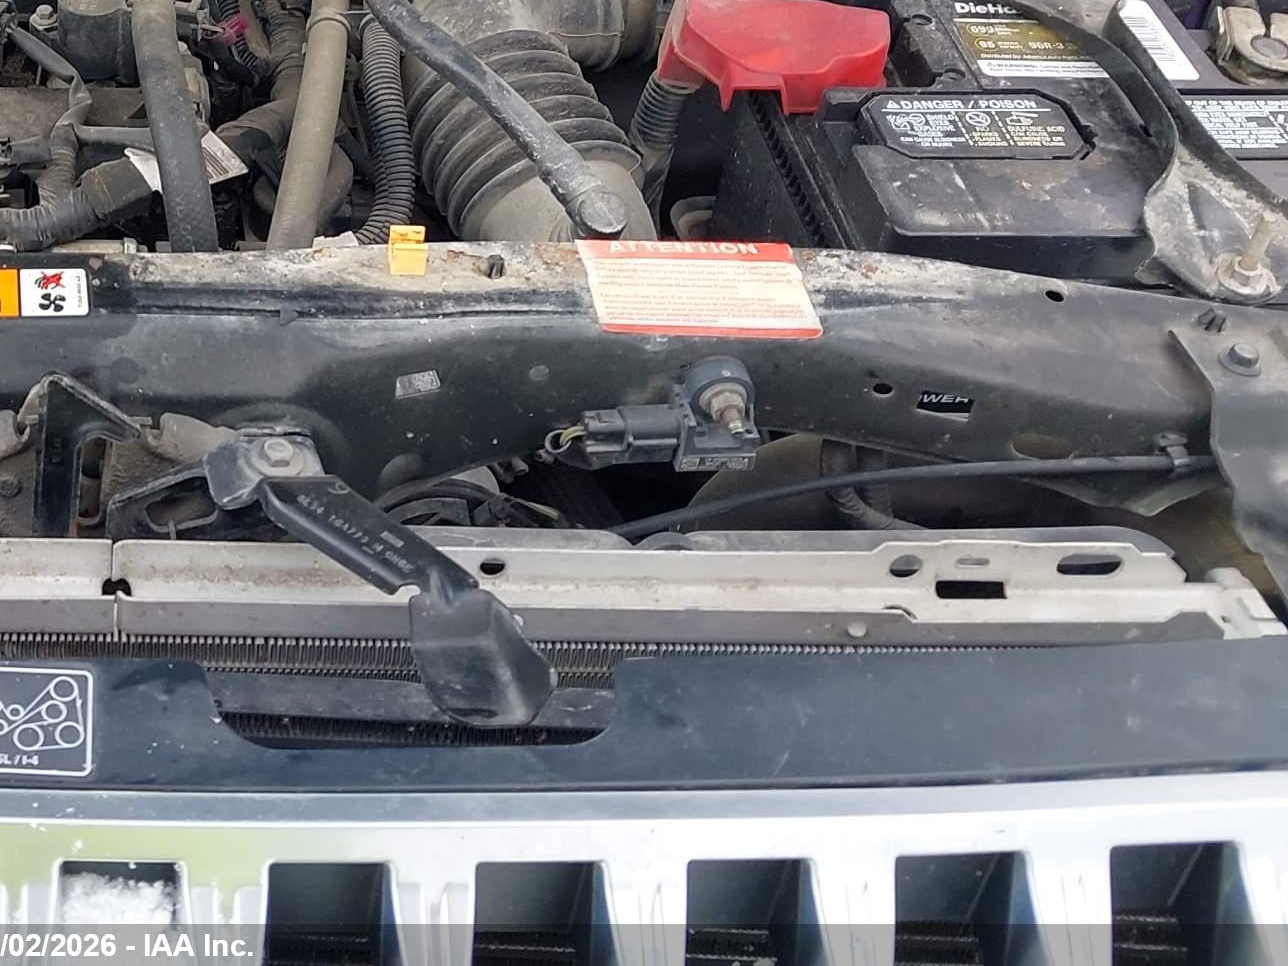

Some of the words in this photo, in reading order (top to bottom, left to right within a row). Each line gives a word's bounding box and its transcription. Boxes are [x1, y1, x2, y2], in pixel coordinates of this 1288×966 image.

[900, 100, 963, 110] DANGER
[978, 100, 1038, 109] POISON
[609, 241, 759, 254] ATTENTION
